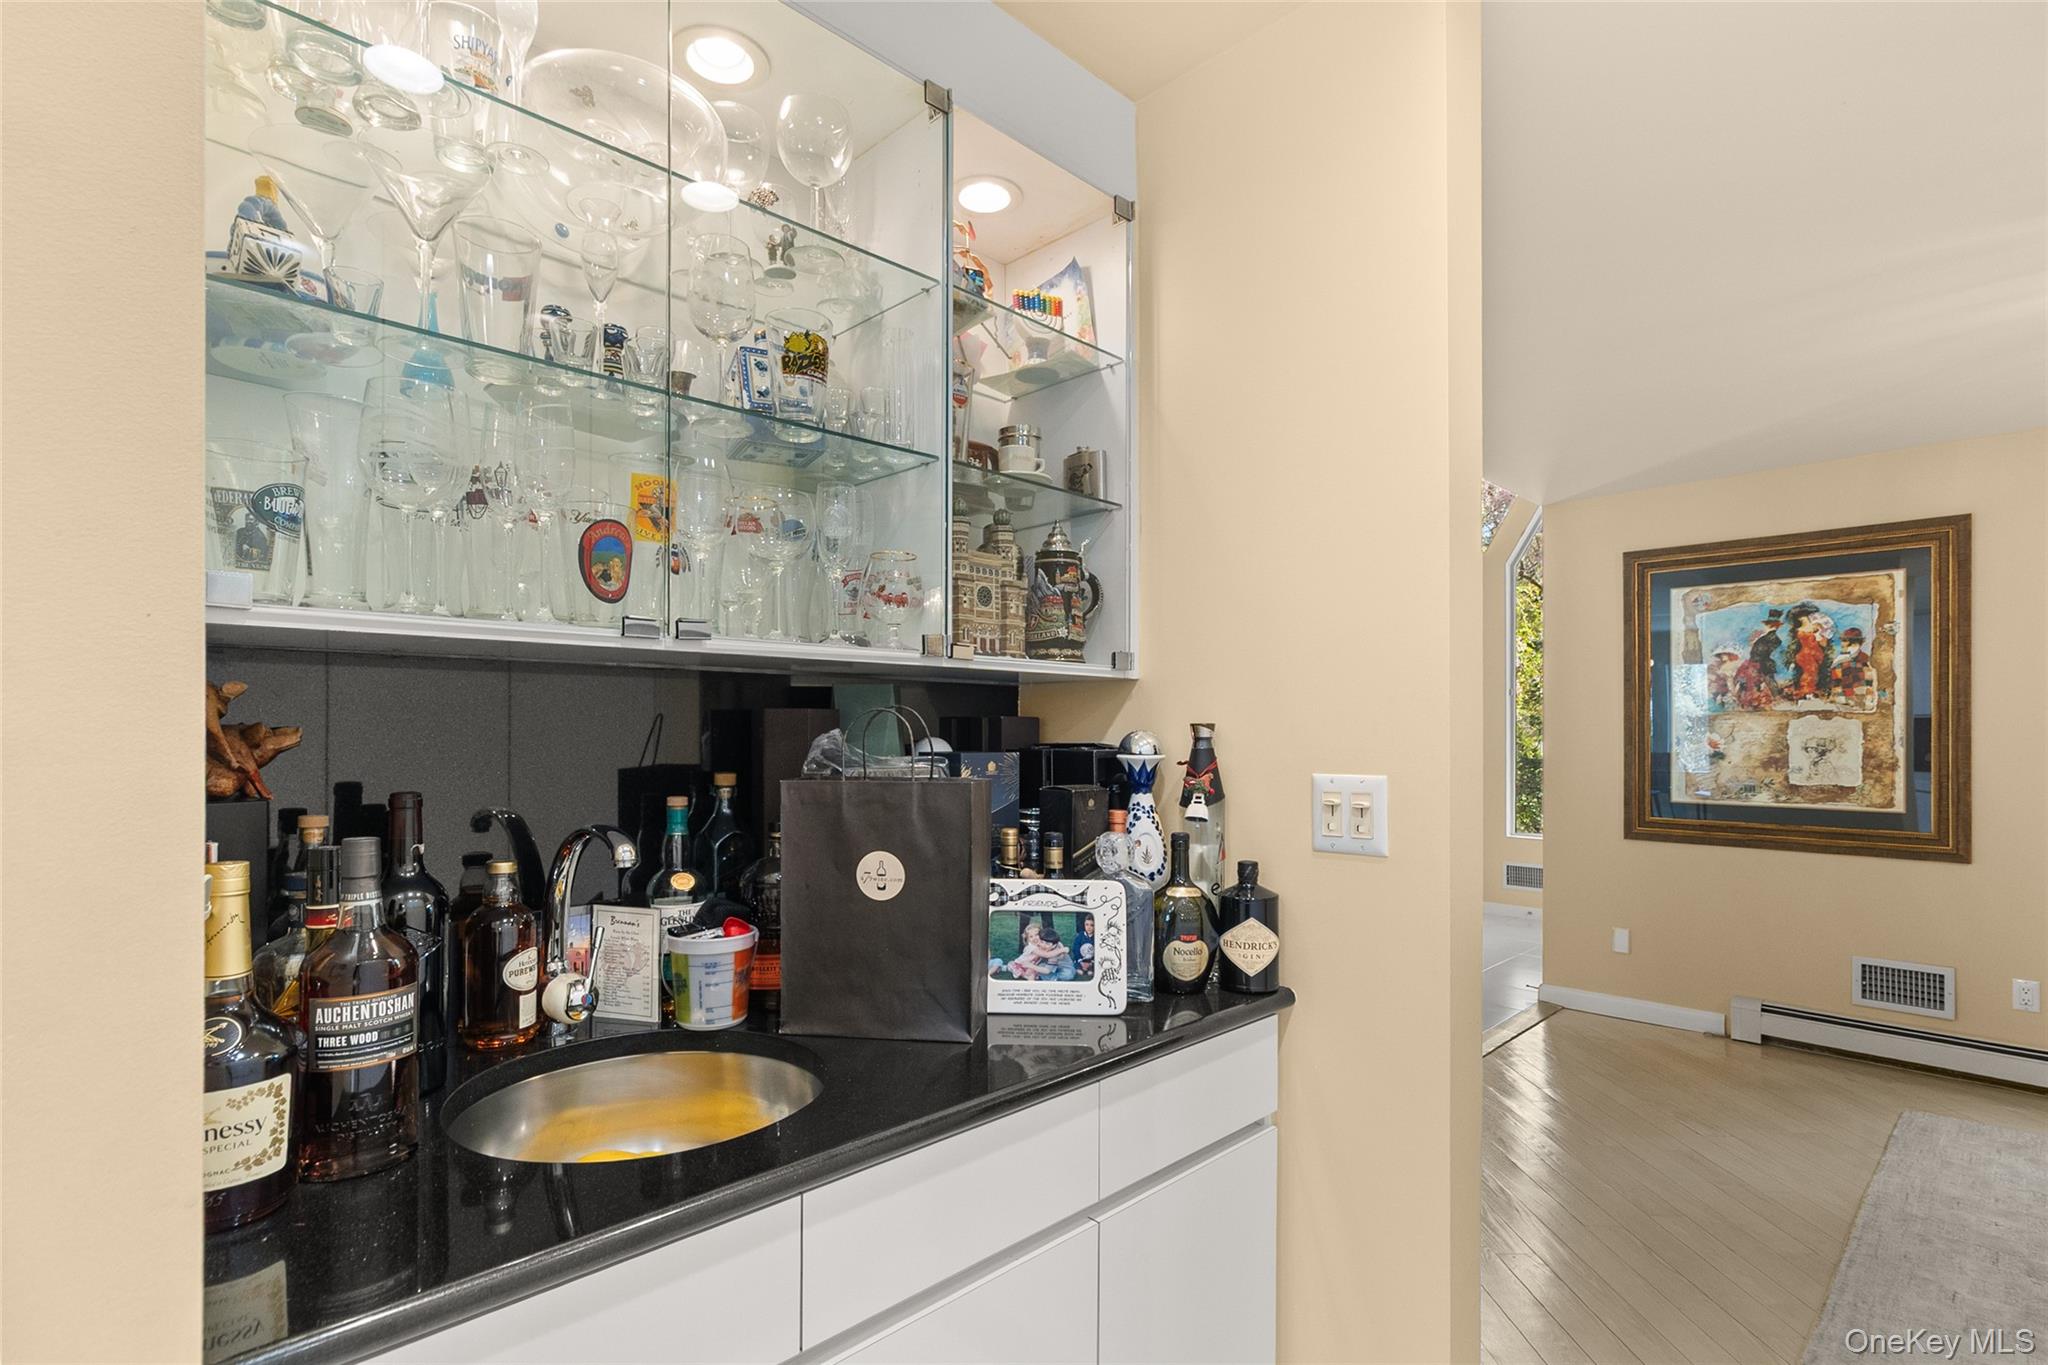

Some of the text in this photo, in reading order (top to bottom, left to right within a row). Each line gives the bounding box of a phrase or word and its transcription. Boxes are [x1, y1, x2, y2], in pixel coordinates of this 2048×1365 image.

[1173, 946, 1204, 956] Nocello
[1222, 938, 1278, 951] HENDRICK'S
[314, 992, 415, 1024] AUCHENTOSHAN
[314, 1024, 340, 1032] SINGLE
[342, 1021, 361, 1030] MALT
[364, 1016, 393, 1028] SCOTCH
[317, 1030, 379, 1049] THREE WOOD
[203, 1115, 267, 1142] nessy
